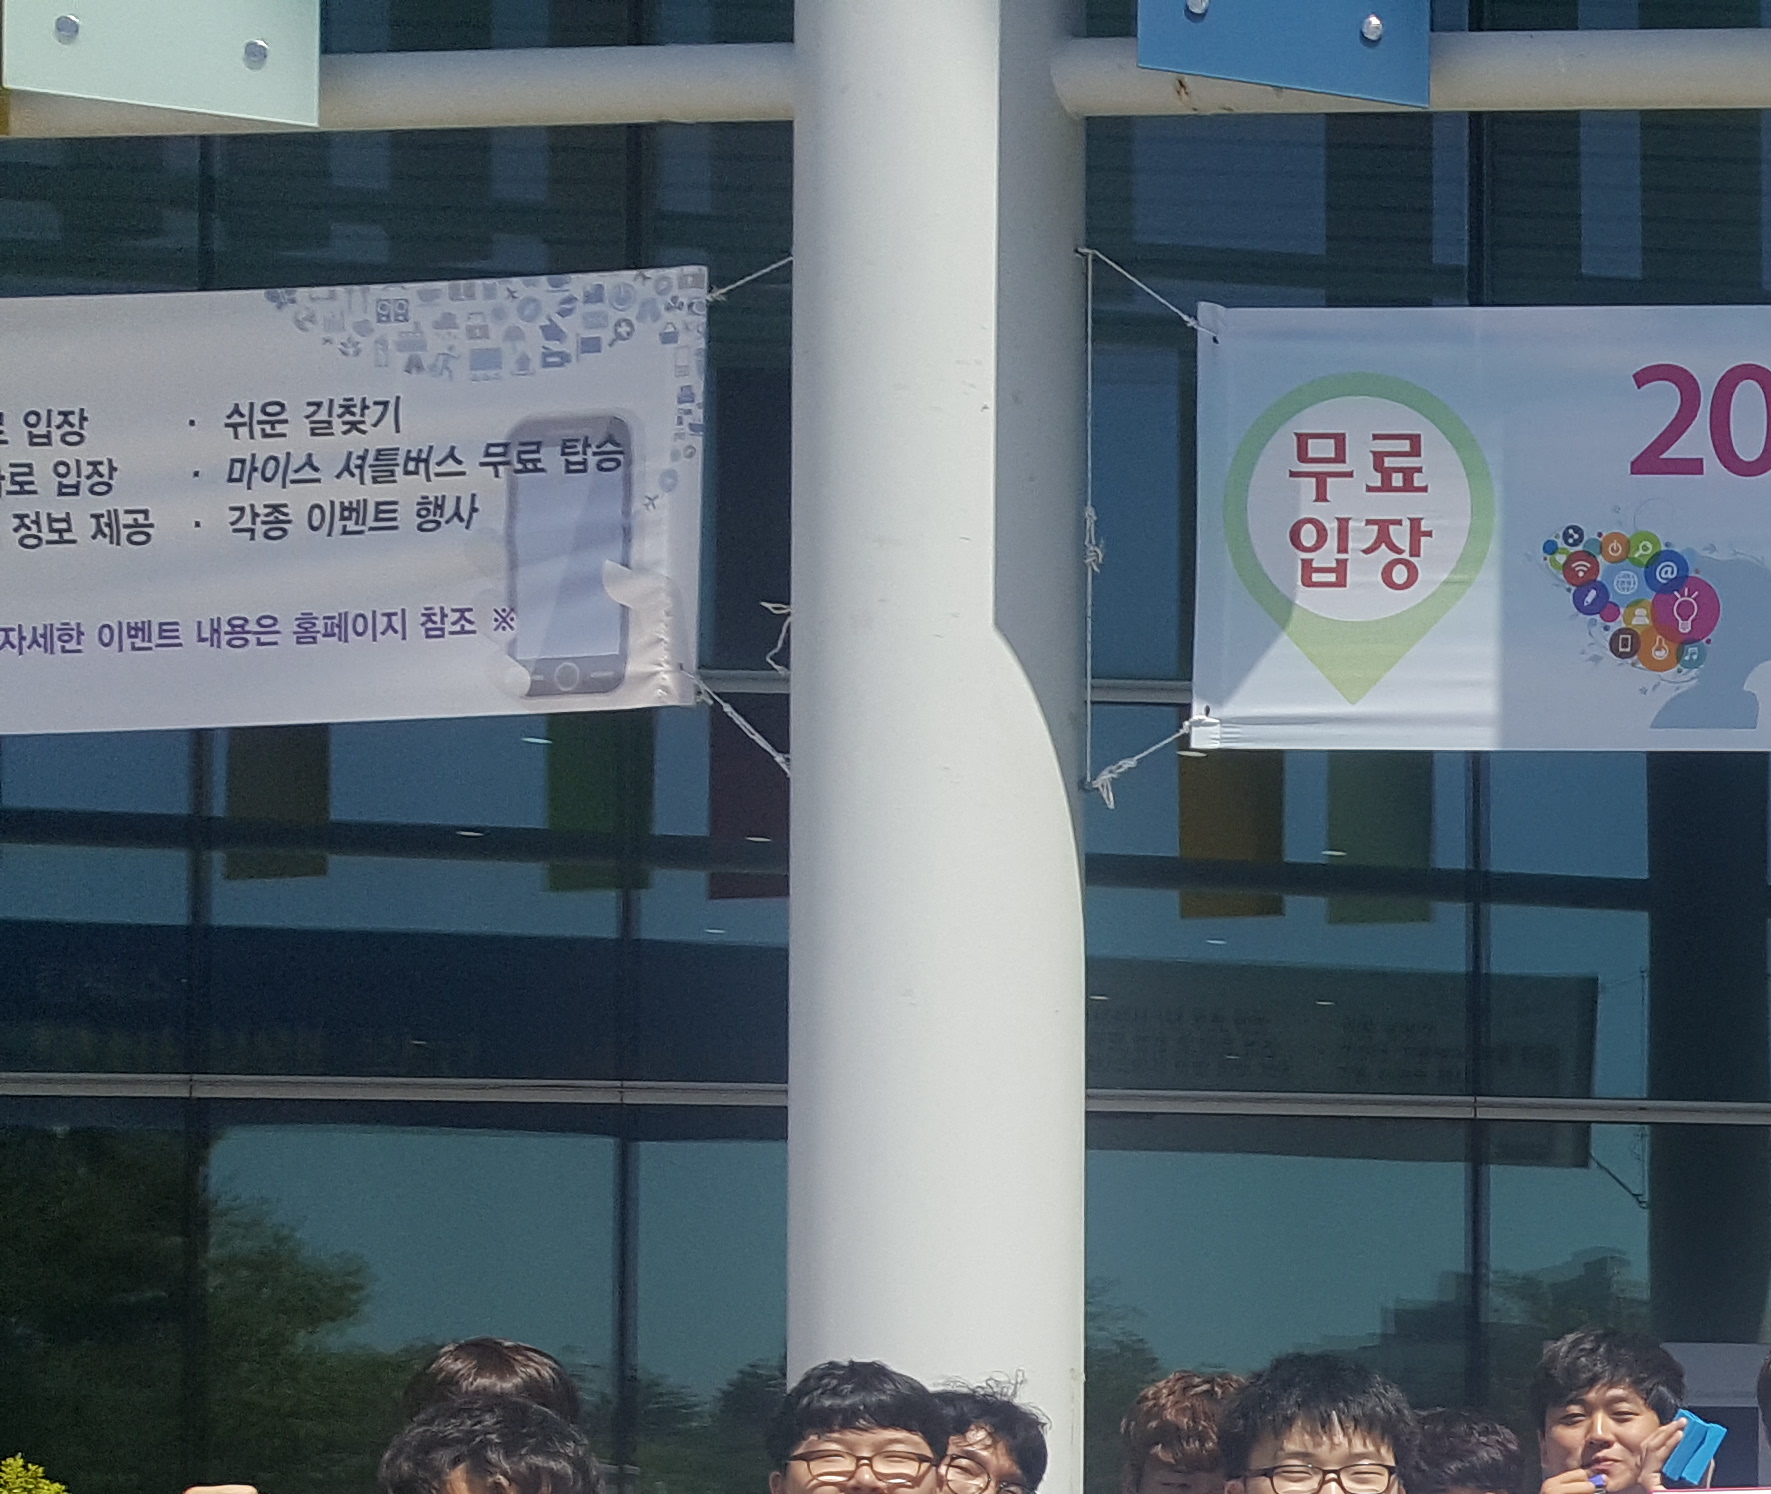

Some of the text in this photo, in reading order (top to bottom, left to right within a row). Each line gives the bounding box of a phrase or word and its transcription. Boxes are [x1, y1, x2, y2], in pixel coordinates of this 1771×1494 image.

[23, 407, 89, 447] 입장
[224, 396, 402, 440] 쉬운 길찾기
[52, 457, 118, 497] 입장
[226, 436, 625, 490] 마이스 셔틀버스 무료 탑승
[1287, 431, 1431, 503] 무료
[12, 508, 154, 550] 정보 제공
[228, 493, 479, 541] 각종 이벤트 행사
[1287, 516, 1433, 591] 입장
[0, 621, 84, 655] 자세한
[97, 619, 183, 653] 이벤트
[196, 613, 281, 651] 내용은
[292, 608, 408, 647] 홈페이지
[420, 603, 478, 639] 참조
